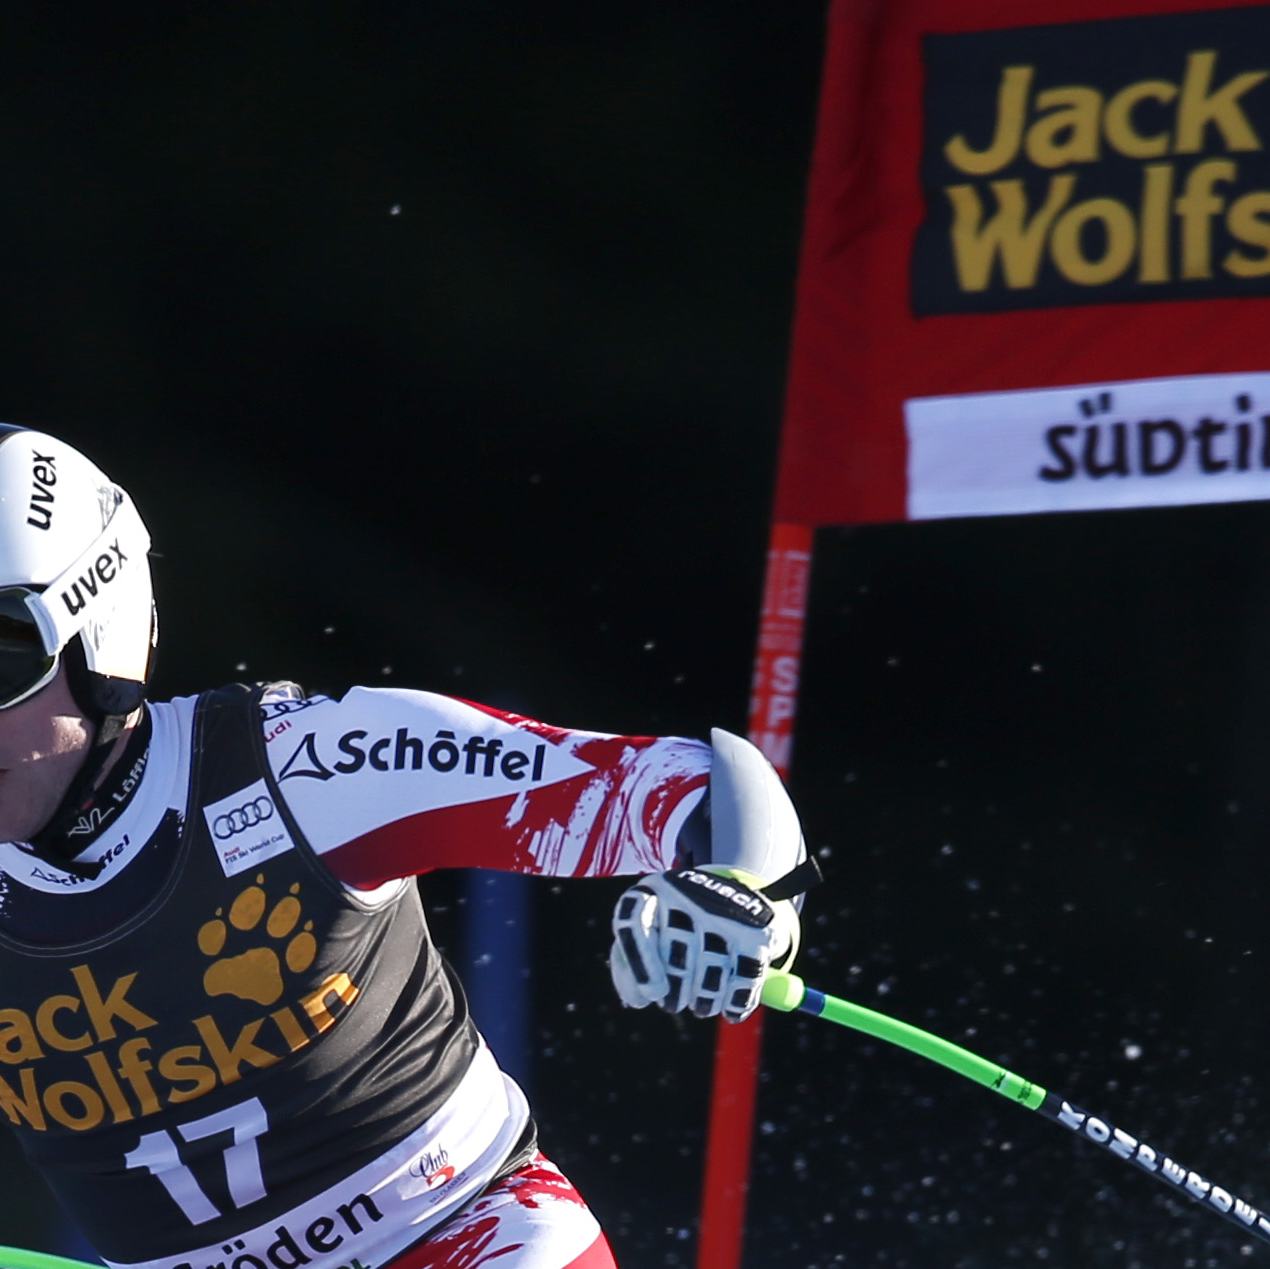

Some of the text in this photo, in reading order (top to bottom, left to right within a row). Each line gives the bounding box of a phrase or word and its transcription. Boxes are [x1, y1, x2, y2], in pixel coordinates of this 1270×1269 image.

[945, 51, 1270, 174] Jack
[27, 449, 57, 531] uvex
[61, 537, 128, 616] uvex
[263, 719, 293, 743] udi
[333, 727, 546, 782] Schöffel
[677, 870, 764, 917] reusch
[124, 1097, 269, 1226] 17
[409, 1143, 449, 1179] Club
